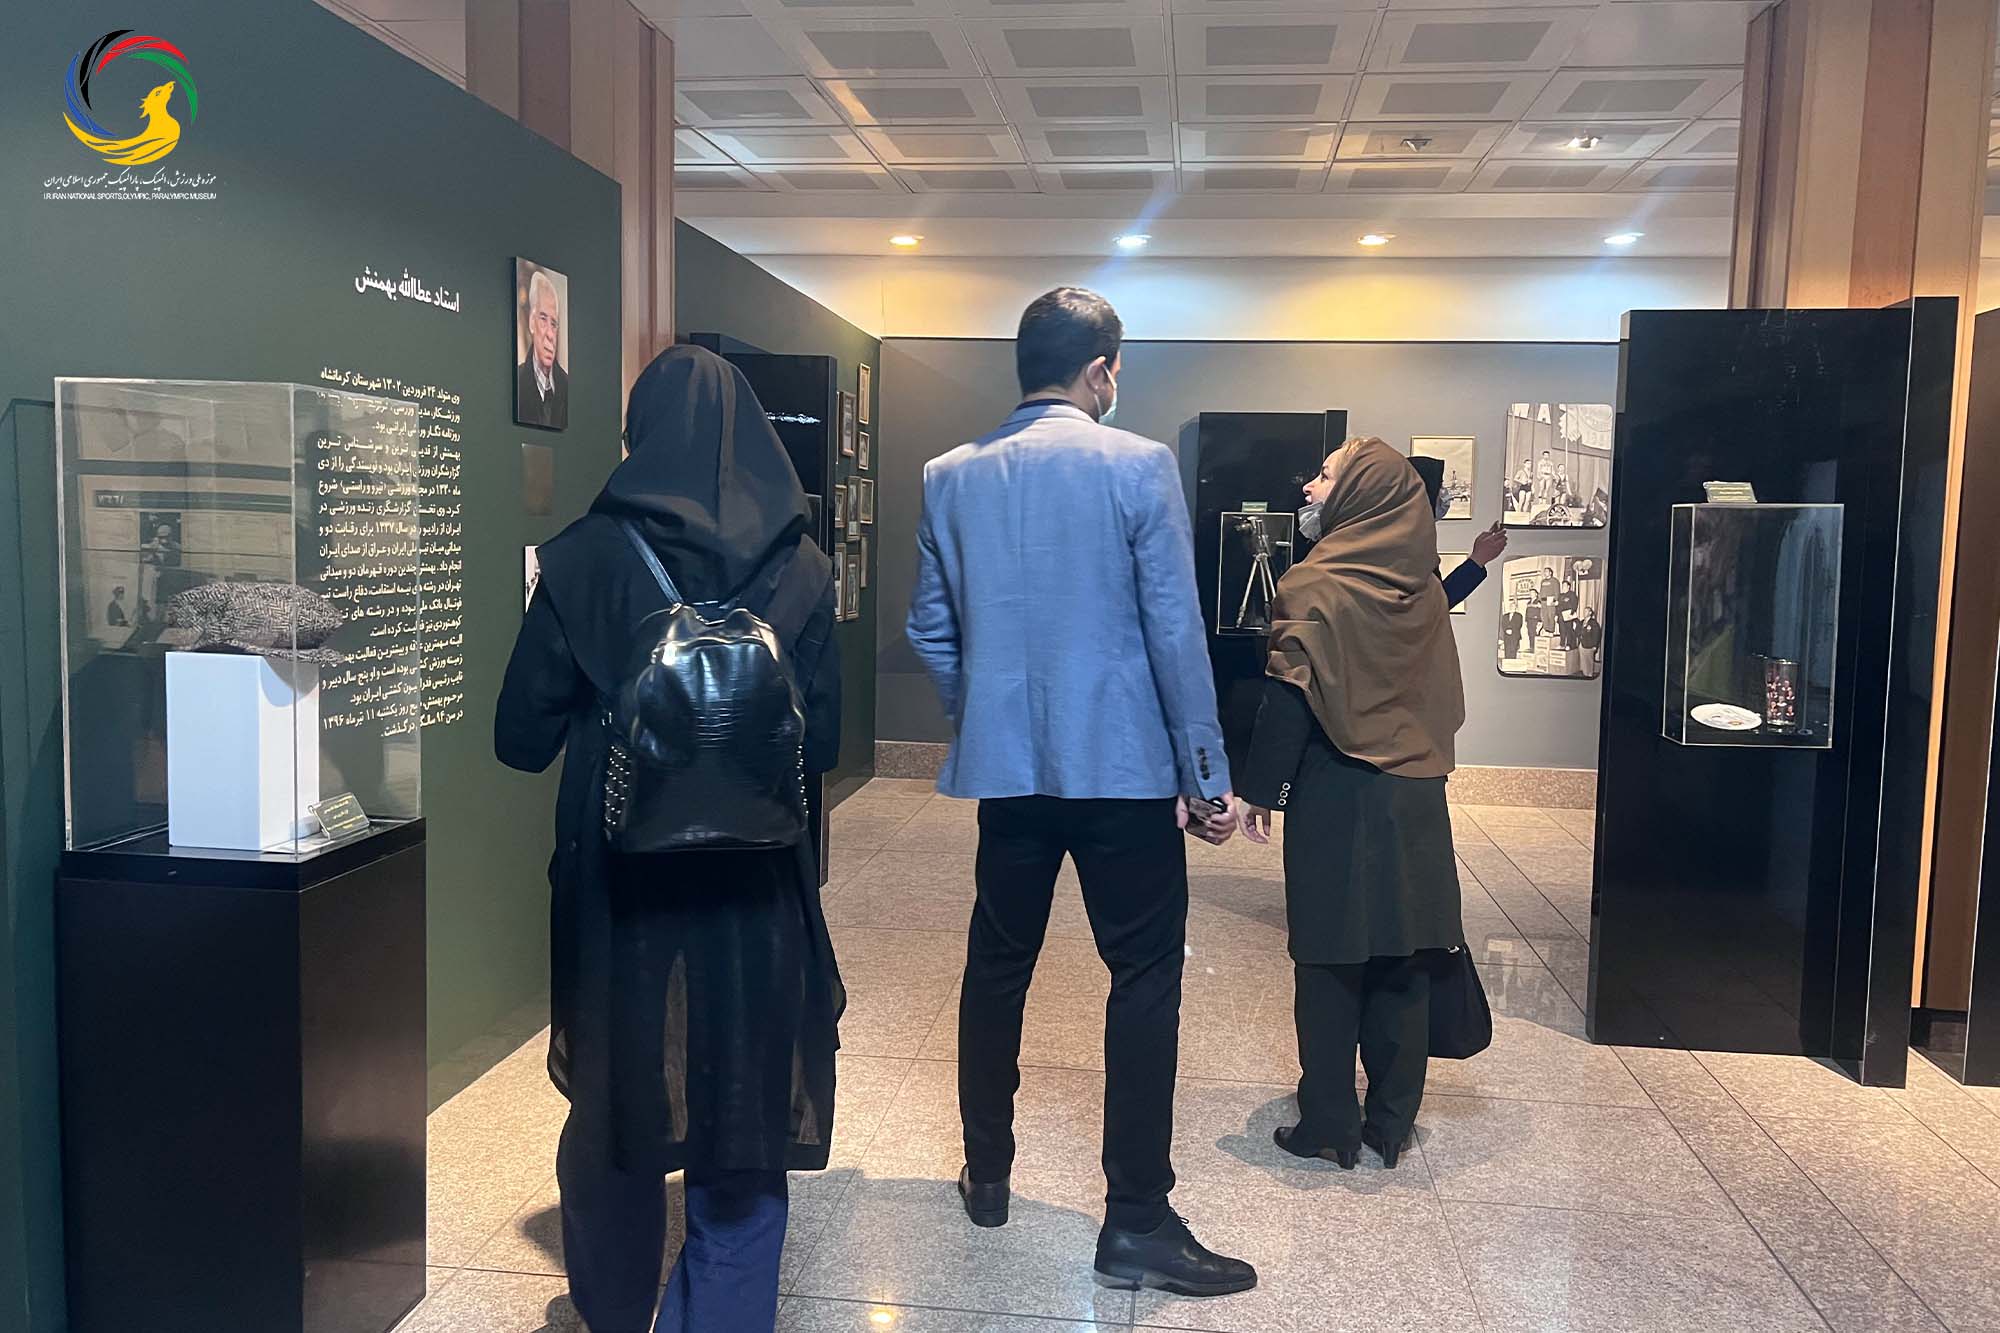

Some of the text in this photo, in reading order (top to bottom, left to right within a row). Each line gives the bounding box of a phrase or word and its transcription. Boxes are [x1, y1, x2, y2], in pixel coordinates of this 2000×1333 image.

[355, 266, 397, 301] بهمنش
[433, 286, 460, 312] استاد
[320, 367, 351, 386] کرمانشاه
[352, 373, 382, 391] شهرستان
[402, 384, 427, 399] فروردین
[437, 388, 451, 402] متولد
[416, 408, 431, 419] مدی
[317, 435, 341, 449] ترین
[344, 436, 383, 454] سرشناس
[391, 442, 409, 456] ترین
[411, 444, 431, 458] قدیی
[432, 445, 439, 459] از
[440, 447, 460, 461] بهمنش
[317, 457, 330, 470] دی
[331, 456, 338, 470] از
[338, 456, 345, 469] را
[345, 456, 378, 474] نویسندگی
[378, 465, 383, 474] و
[394, 461, 412, 477] ایران
[383, 465, 393, 476] بود
[431, 463, 460, 480] گزارشگران
[318, 478, 338, 496] شروع
[387, 482, 411, 497] ورزشی
[411, 484, 428, 497] مجه
[319, 502, 328, 514] در
[329, 500, 356, 516] ورزشی
[357, 502, 375, 514] زنده
[376, 499, 412, 517] گزارشگری
[436, 507, 446, 517] وی
[446, 503, 461, 518] کرد
[335, 521, 359, 537] رقابت
[359, 521, 374, 537] برای
[445, 522, 462, 537] ایران
[319, 543, 340, 559] ایران
[340, 541, 361, 557] صدای
[361, 541, 368, 557] از
[368, 540, 387, 558] عراق
[391, 540, 407, 558] ایران
[320, 565, 342, 582] میدانی
[343, 569, 348, 579] و
[347, 566, 356, 579] دو
[358, 563, 383, 579] قهرمان
[383, 564, 398, 577] دوره
[332, 585, 353, 600] راست
[353, 584, 368, 602] دفاع
[437, 581, 445, 593] در
[445, 579, 462, 592] تهران
[401, 604, 417, 616] بوده
[428, 599, 443, 612] بانک
[443, 596, 462, 610] فوتبال
[351, 606, 365, 621] های
[366, 605, 385, 618] رشته
[386, 607, 395, 618] در
[395, 608, 400, 617] و
[387, 621, 402, 637] کرده
[433, 614, 462, 631] کوهنوردی
[355, 645, 376, 661] فعالیت
[446, 653, 463, 666] زمینه
[381, 663, 396, 677] است
[397, 664, 409, 676] بوده
[428, 657, 446, 671] ورزش
[342, 670, 357, 685] سال
[358, 669, 369, 685] پنج
[369, 666, 377, 681] او
[376, 670, 380, 680] و
[322, 679, 327, 690] و
[327, 675, 341, 689] دبیر
[363, 685, 382, 703] ایران
[382, 681, 403, 700] کشتی
[443, 692, 463, 708] مرحوم
[377, 703, 398, 718] یکشنبه
[399, 703, 409, 716] روز
[455, 709, 463, 720] در
[323, 714, 344, 730] ۱۳۹۶
